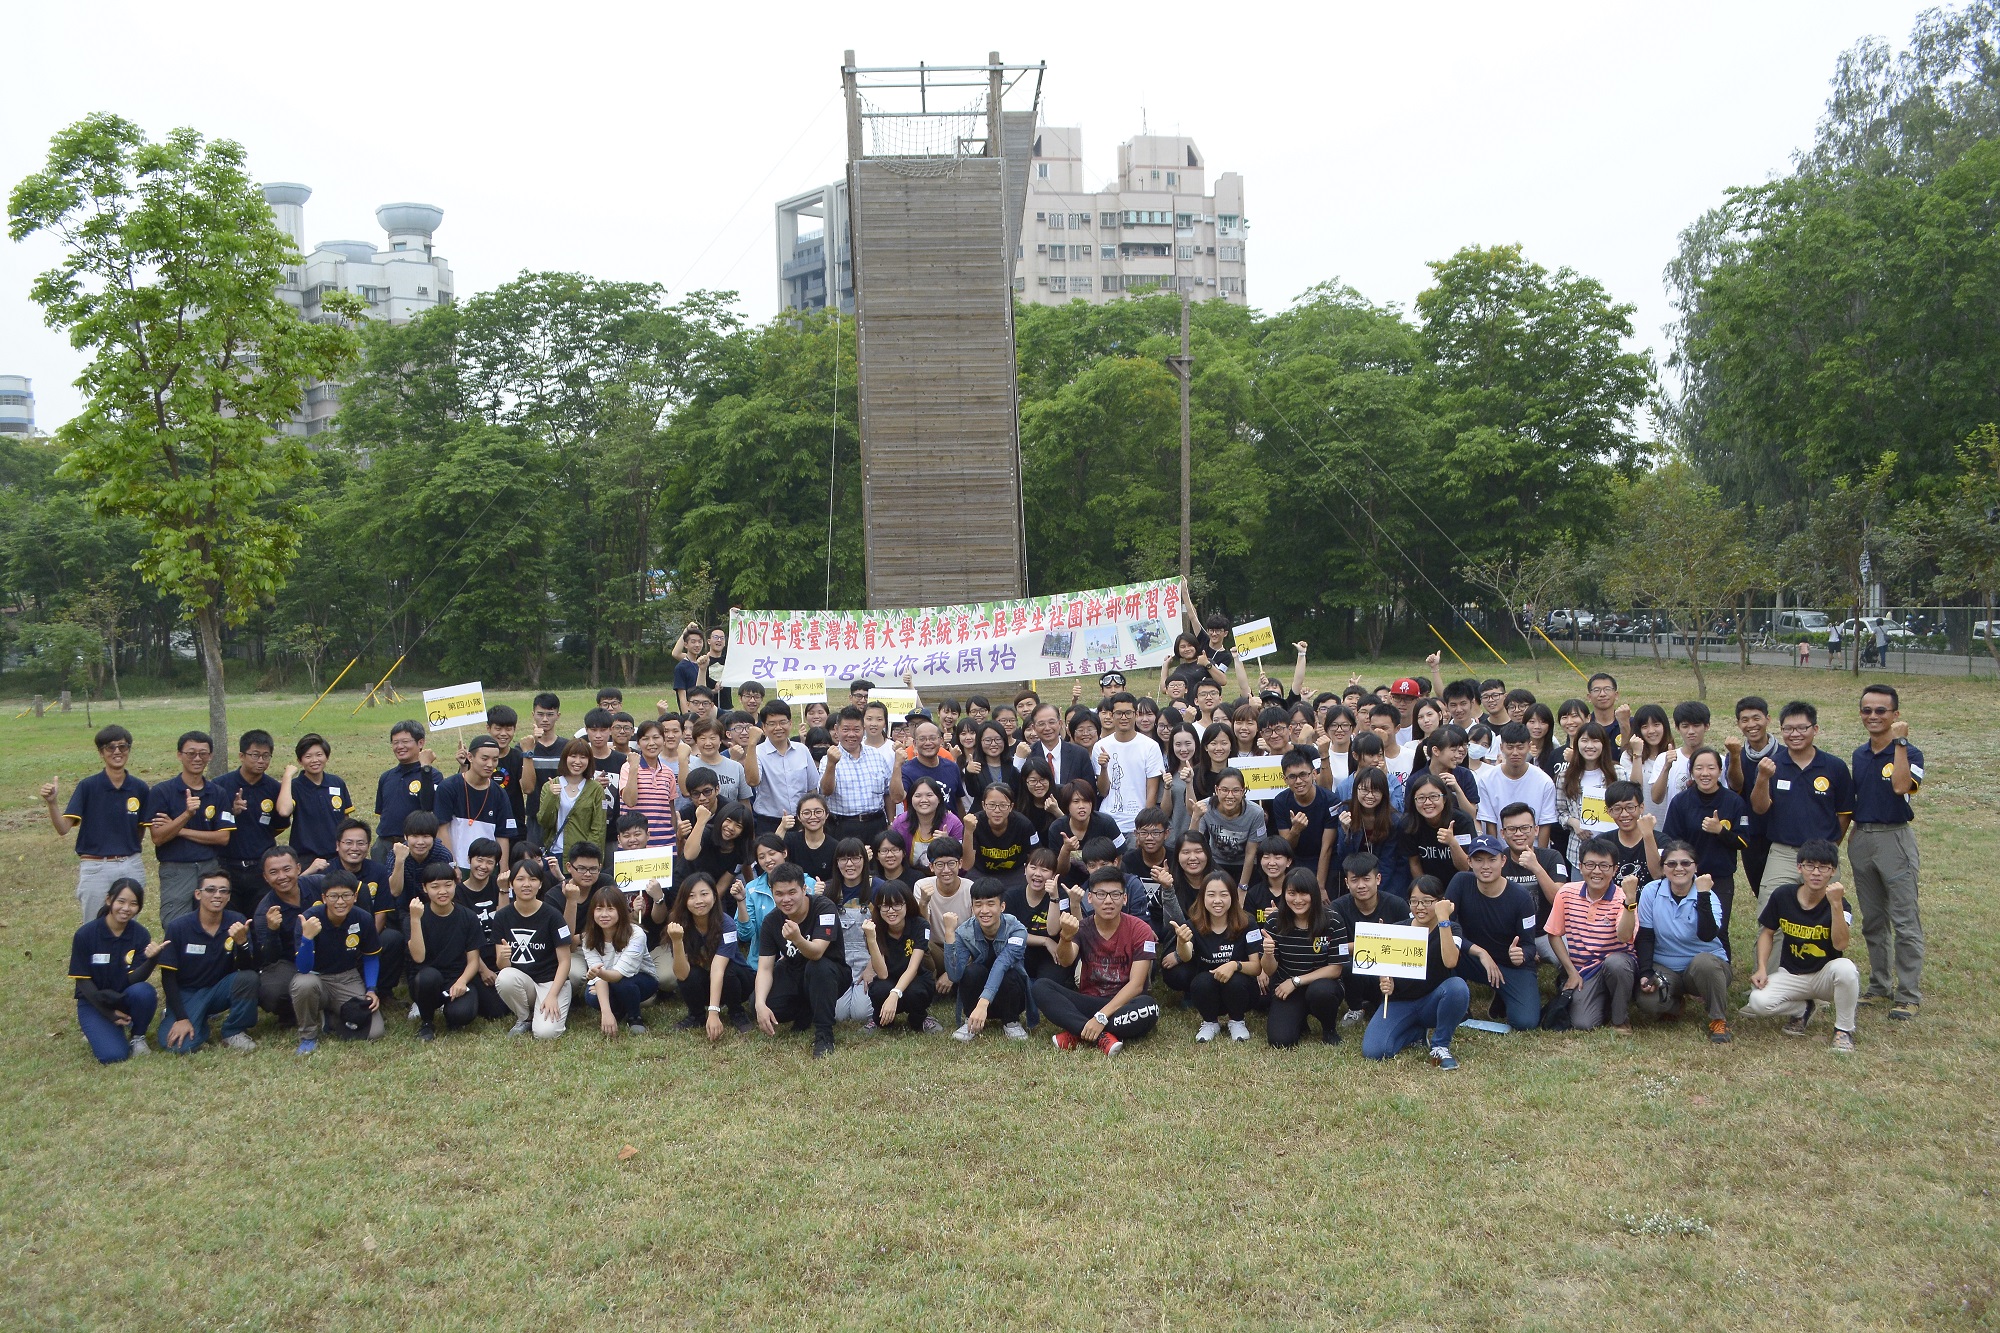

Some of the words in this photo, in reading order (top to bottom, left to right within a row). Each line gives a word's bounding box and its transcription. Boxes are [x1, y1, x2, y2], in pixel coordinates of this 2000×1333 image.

[737, 583, 1180, 651] 107年度臺灣教育大學系統第六屆學生社團幹部研習營
[1048, 654, 1137, 677] 國立臺南大學
[794, 682, 824, 691] 第六小隊
[447, 697, 482, 711] 第四小隊
[1209, 823, 1224, 834] THE
[635, 862, 670, 873] 第三小隊
[1380, 944, 1424, 957] 第一小隊
